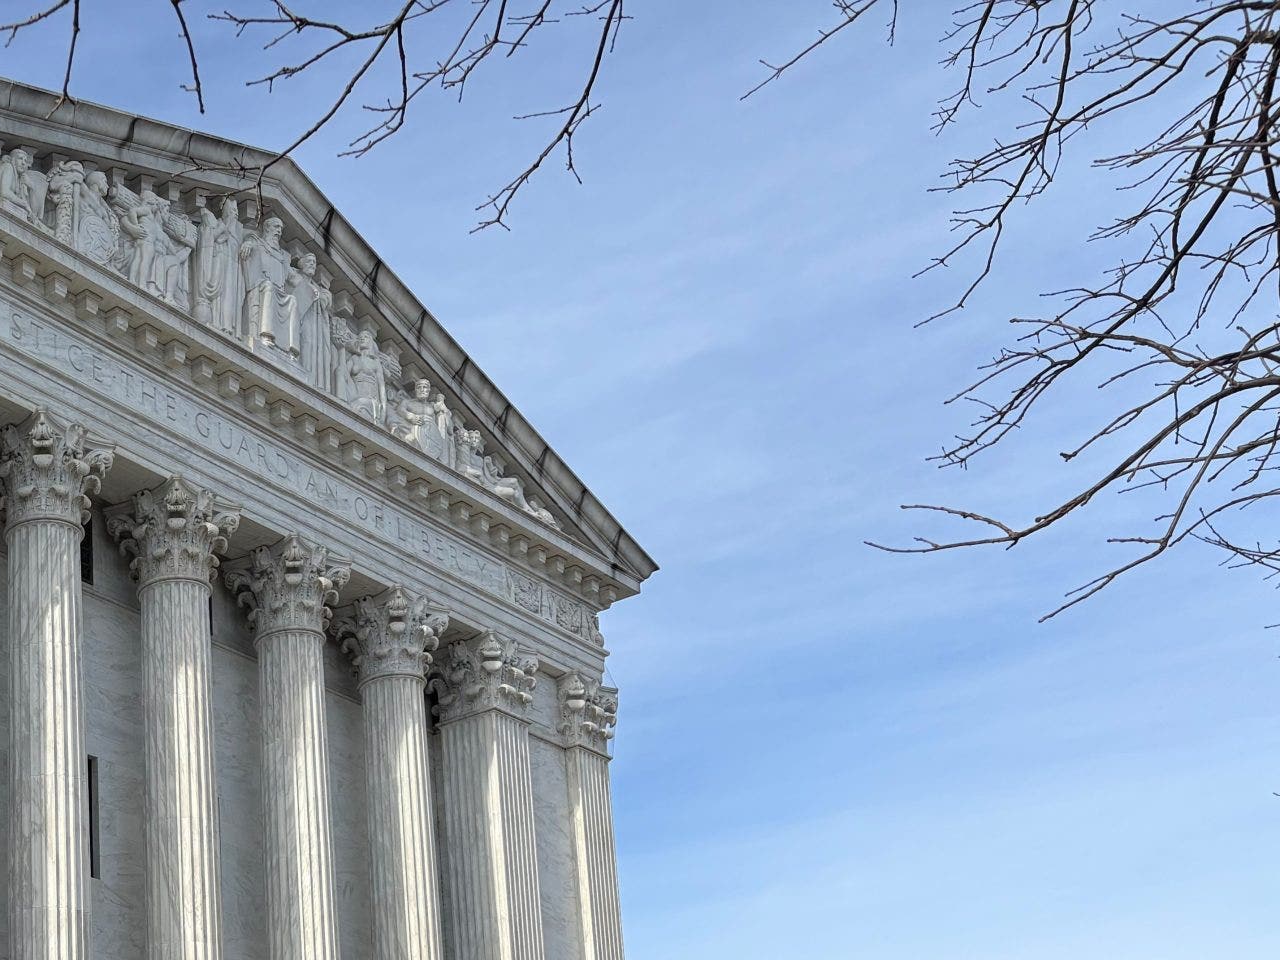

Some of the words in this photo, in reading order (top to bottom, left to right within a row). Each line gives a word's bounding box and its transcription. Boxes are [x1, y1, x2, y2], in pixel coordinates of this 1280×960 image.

[120, 370, 176, 422] THE
[194, 412, 338, 500] GUARDIAN
[354, 496, 385, 530] OF
[396, 517, 488, 574] LIBERTY
